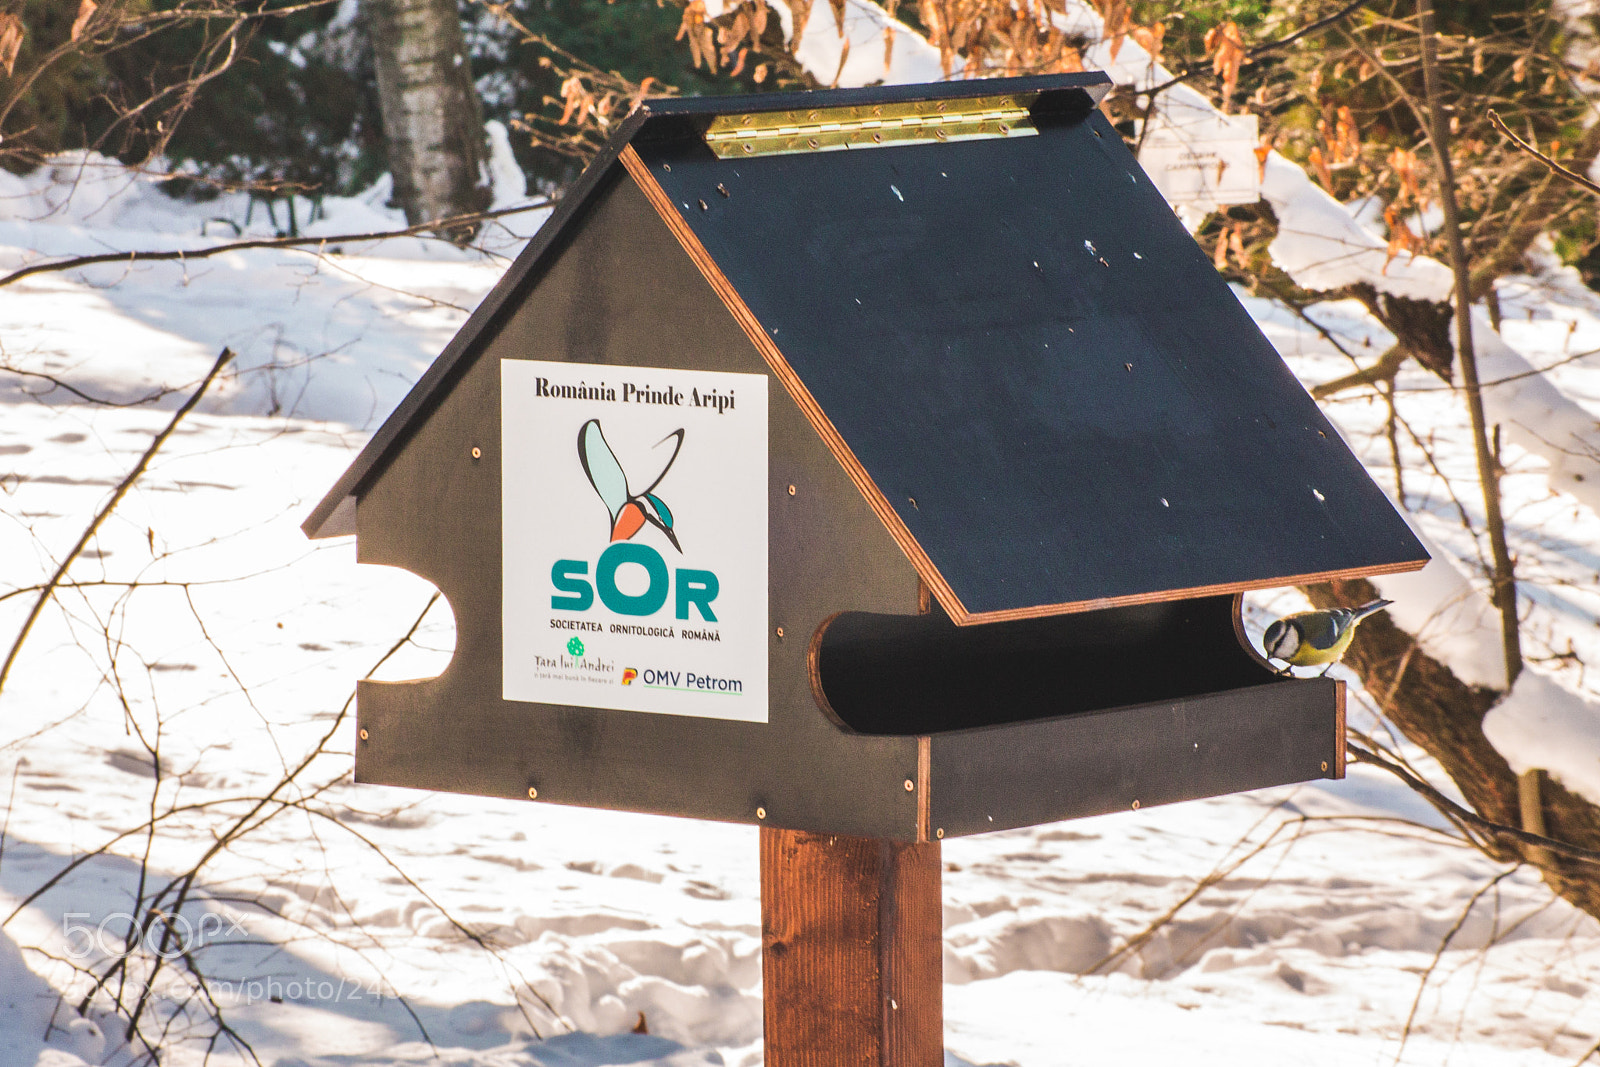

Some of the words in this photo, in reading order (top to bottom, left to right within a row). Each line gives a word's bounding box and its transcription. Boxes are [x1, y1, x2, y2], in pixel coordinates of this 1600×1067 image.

[535, 376, 617, 402] România
[622, 382, 684, 406] Prinde
[688, 386, 736, 415] Aripi
[550, 542, 720, 623] SOR
[550, 618, 603, 632] SOCIETATEA
[609, 623, 675, 638] ORNITOLOGICĂ
[681, 628, 721, 642] ROMÂNĂ
[560, 654, 573, 669] lui
[580, 657, 615, 673] Andrei
[643, 669, 681, 687] OMV
[686, 672, 743, 692] Petrom
